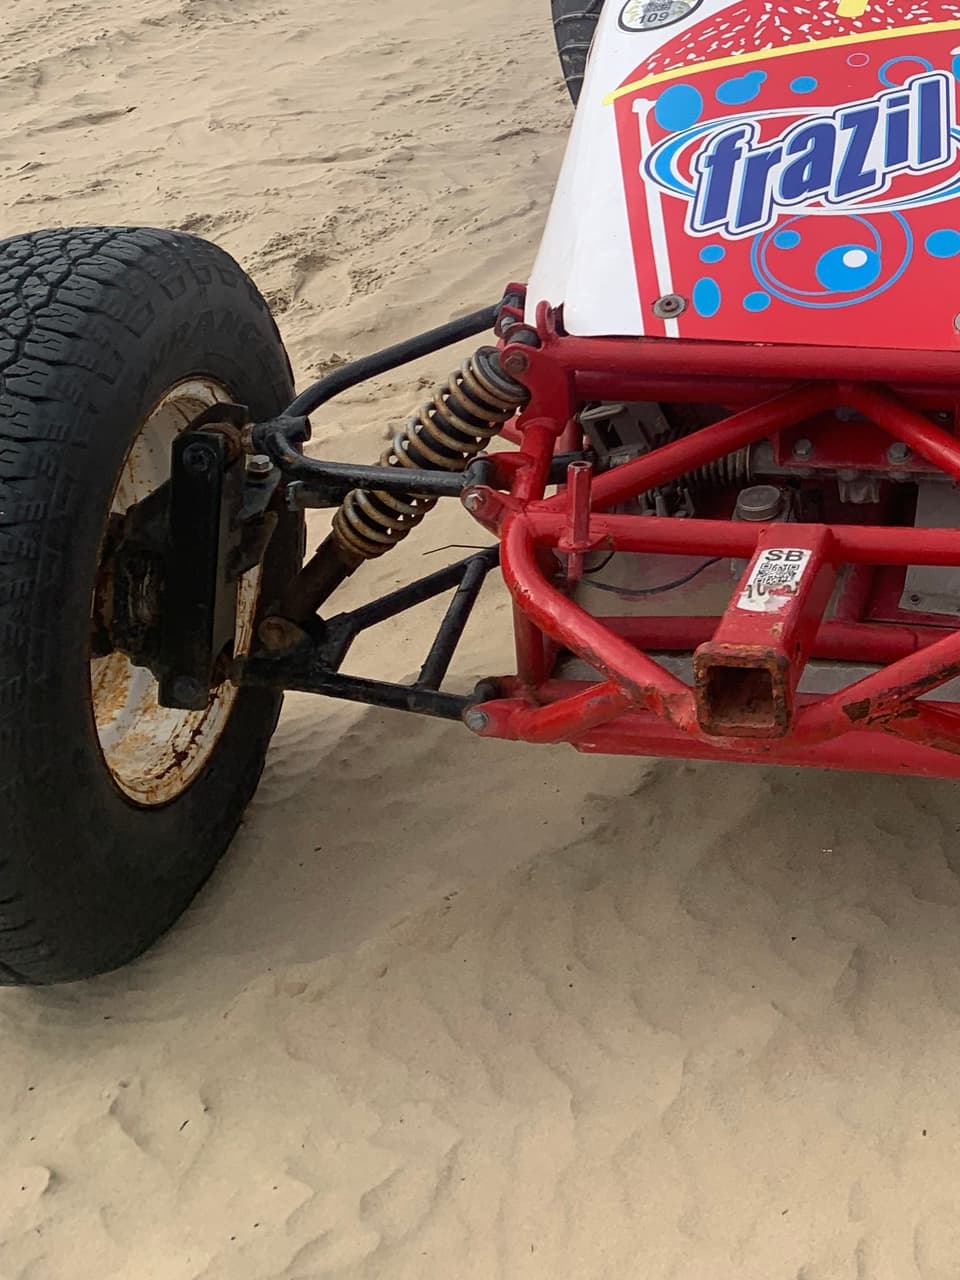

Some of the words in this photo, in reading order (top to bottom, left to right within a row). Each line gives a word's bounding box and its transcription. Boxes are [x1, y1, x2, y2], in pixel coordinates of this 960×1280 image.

[638, 11, 670, 25] 109
[690, 72, 953, 236] frazil
[765, 549, 804, 562] SB
[746, 581, 799, 599] 10
